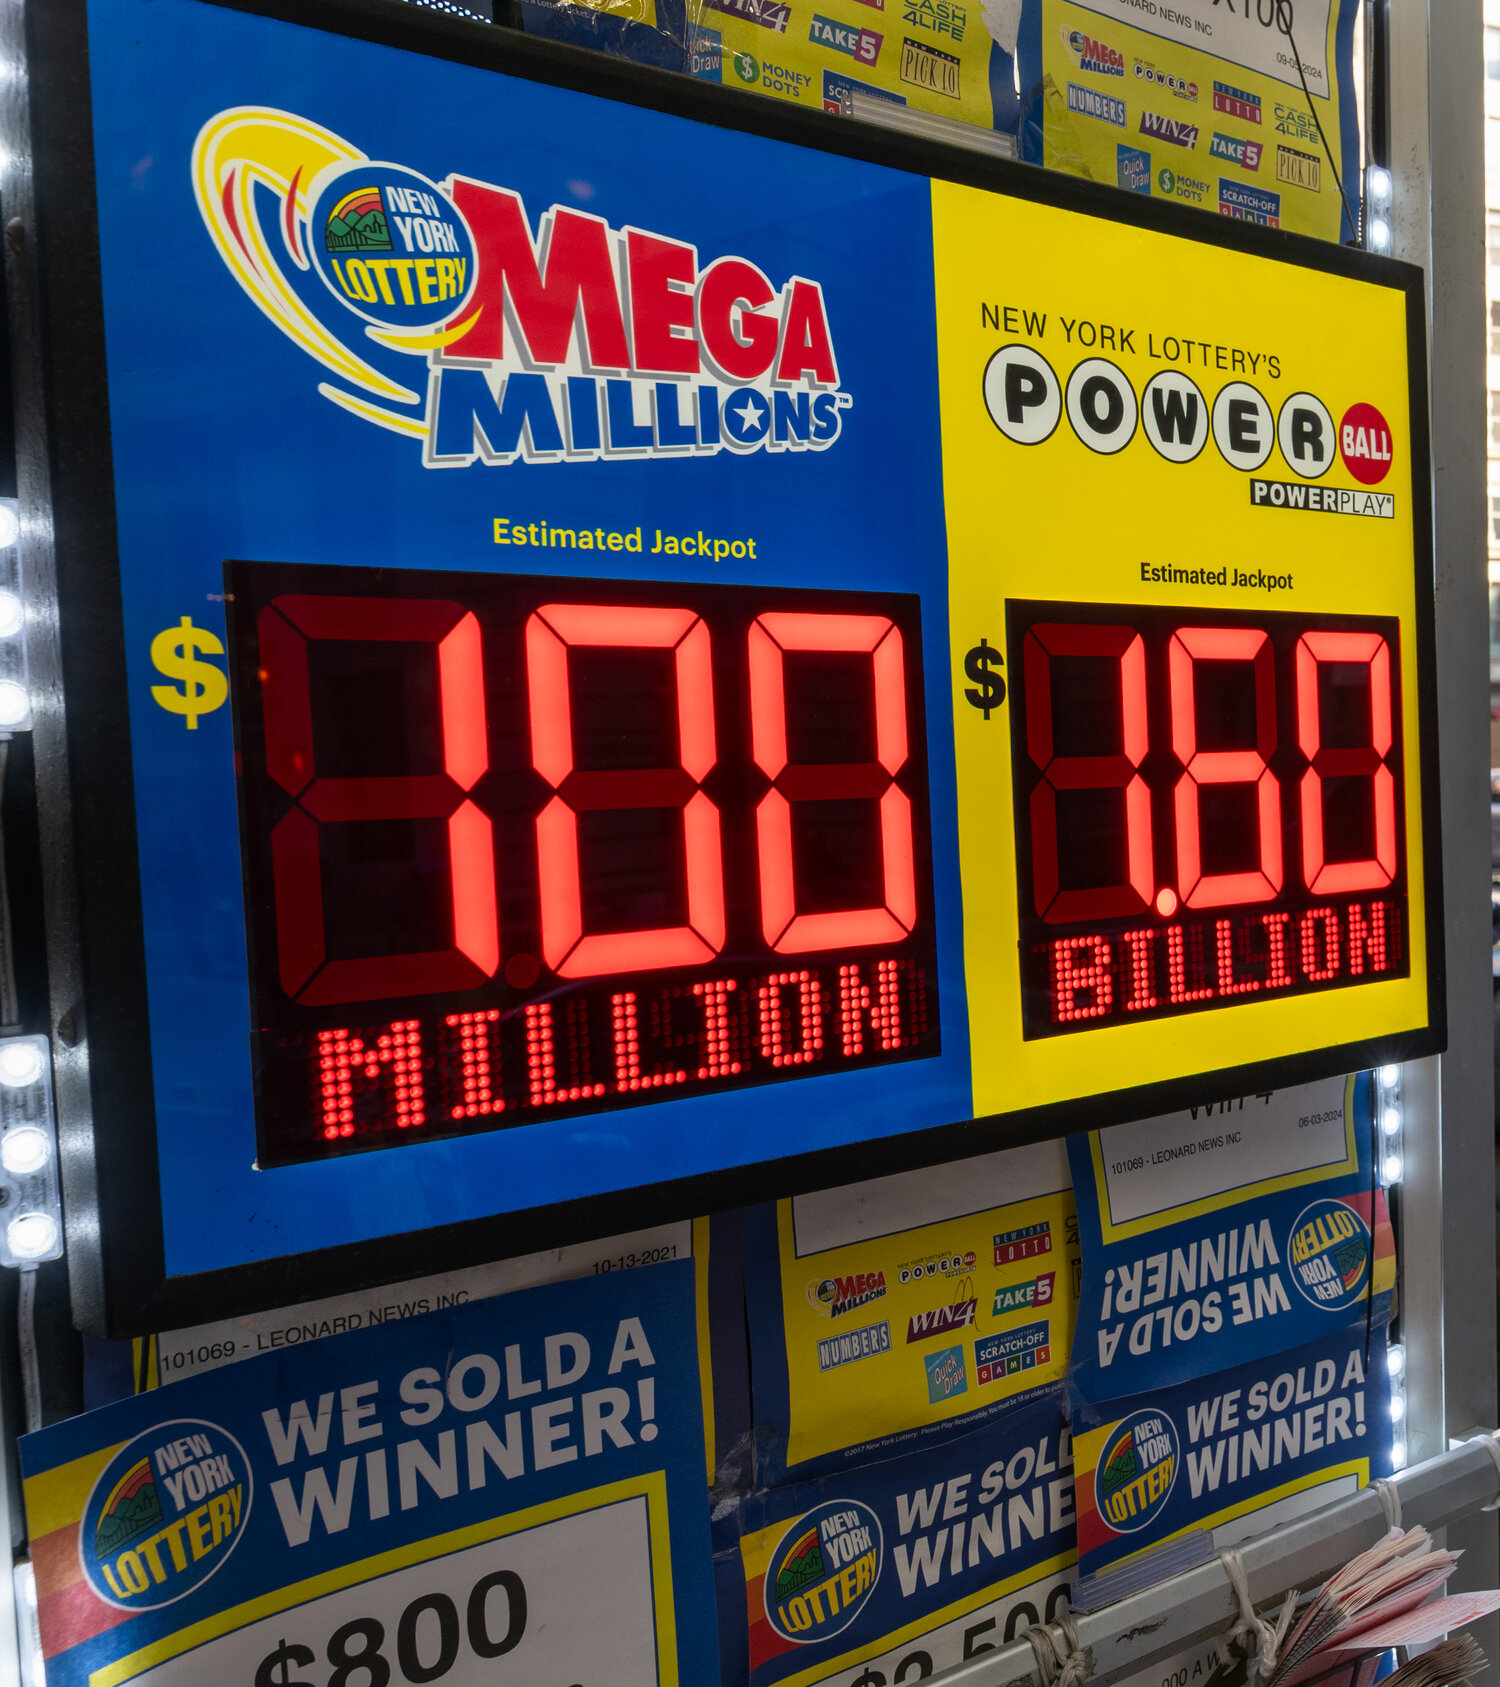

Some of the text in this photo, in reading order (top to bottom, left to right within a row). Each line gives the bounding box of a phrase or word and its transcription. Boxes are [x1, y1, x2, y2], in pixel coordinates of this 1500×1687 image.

[902, 10, 964, 42] 4LIFE
[1159, 6, 1192, 29] NEWS
[1194, 19, 1213, 37] INC
[691, 55, 720, 74] Draw
[1080, 57, 1125, 78] MILLIONS
[1081, 34, 1125, 69] MEGA
[1276, 52, 1322, 79] 09-052024
[762, 61, 812, 88] MONEY
[762, 75, 801, 98] DOTS
[904, 48, 956, 94] PICK 10
[1069, 83, 1125, 124] NUMBERS
[1215, 95, 1260, 122] LOTTO
[1274, 107, 1319, 131] CASH
[1275, 122, 1319, 144] 4LIFE
[1123, 156, 1144, 175] Quick
[1131, 172, 1150, 189] Draw
[1280, 153, 1305, 184] PICK
[1176, 174, 1211, 193] MONEY
[1176, 186, 1202, 203] DOTS
[385, 186, 440, 218] NEW
[1222, 189, 1276, 213] SCRATCH-OFF
[393, 216, 460, 253] YORK
[331, 257, 466, 306] LOTTERY
[443, 178, 838, 386] MEGA
[981, 302, 1282, 379] NEW YORK LOTTERY'S
[433, 370, 843, 458] MILLIONS
[492, 517, 757, 564] Estimated Jackpot
[1140, 562, 1294, 592] Estimated Jackpot
[1119, 626, 1397, 918] 1.60
[437, 602, 918, 980] 100
[1053, 900, 1387, 1023] BILLION
[317, 959, 903, 1141] MILLION
[1298, 1110, 1343, 1128] 06-03-2024
[1111, 1156, 1144, 1175] 101069
[1151, 1143, 1197, 1165] LEONARD
[1198, 1135, 1224, 1152] NEWS
[1225, 1131, 1242, 1146] INC
[995, 1232, 1018, 1245] NEW
[1021, 1222, 1049, 1237] YORK
[995, 1236, 1051, 1264] LOTTO
[1292, 1209, 1361, 1266] LOTTERY
[592, 1245, 679, 1275] 10-13-2021
[1100, 1218, 1281, 1321] WINNER!
[1299, 1254, 1337, 1286] YORK
[831, 1286, 887, 1319] MILLIONS
[832, 1270, 886, 1304] MEGA
[1313, 1279, 1344, 1301] NEW
[161, 1341, 236, 1372] 101069
[256, 1314, 362, 1351] LEONARD
[368, 1299, 430, 1330] NEWS
[436, 1289, 470, 1309] INC
[1097, 1272, 1292, 1368] WE SOLD A
[819, 1325, 888, 1367] NUMBERS
[980, 1331, 1045, 1361] SCRATCH-OFF
[934, 1354, 957, 1385] Quick
[943, 1365, 964, 1395] Draw
[981, 1351, 1046, 1379] GAMES
[261, 1316, 656, 1467] WE SOLD A
[1187, 1348, 1366, 1444] WE SOLD A
[866, 1441, 880, 1451] New
[881, 1437, 895, 1447] York
[920, 1425, 940, 1435] Please
[941, 1421, 954, 1430] Play
[988, 1405, 998, 1414] You
[998, 1400, 1010, 1410] must
[1010, 1397, 1017, 1405] be
[1030, 1388, 1044, 1399] older
[1134, 1418, 1163, 1445] NEW
[154, 1433, 213, 1476] NEW
[1137, 1433, 1172, 1470] YORK
[1186, 1390, 1367, 1499] WINNER!
[270, 1377, 660, 1550] WINNER!
[163, 1454, 235, 1512] YORK
[1105, 1453, 1175, 1523] LOTTERY
[895, 1473, 972, 1536] WE
[101, 1483, 243, 1599] LOTTERY
[820, 1510, 861, 1542] NEW
[825, 1526, 872, 1570] YORK
[777, 1548, 877, 1634] LOTTERY
[1192, 1660, 1203, 1681] A
